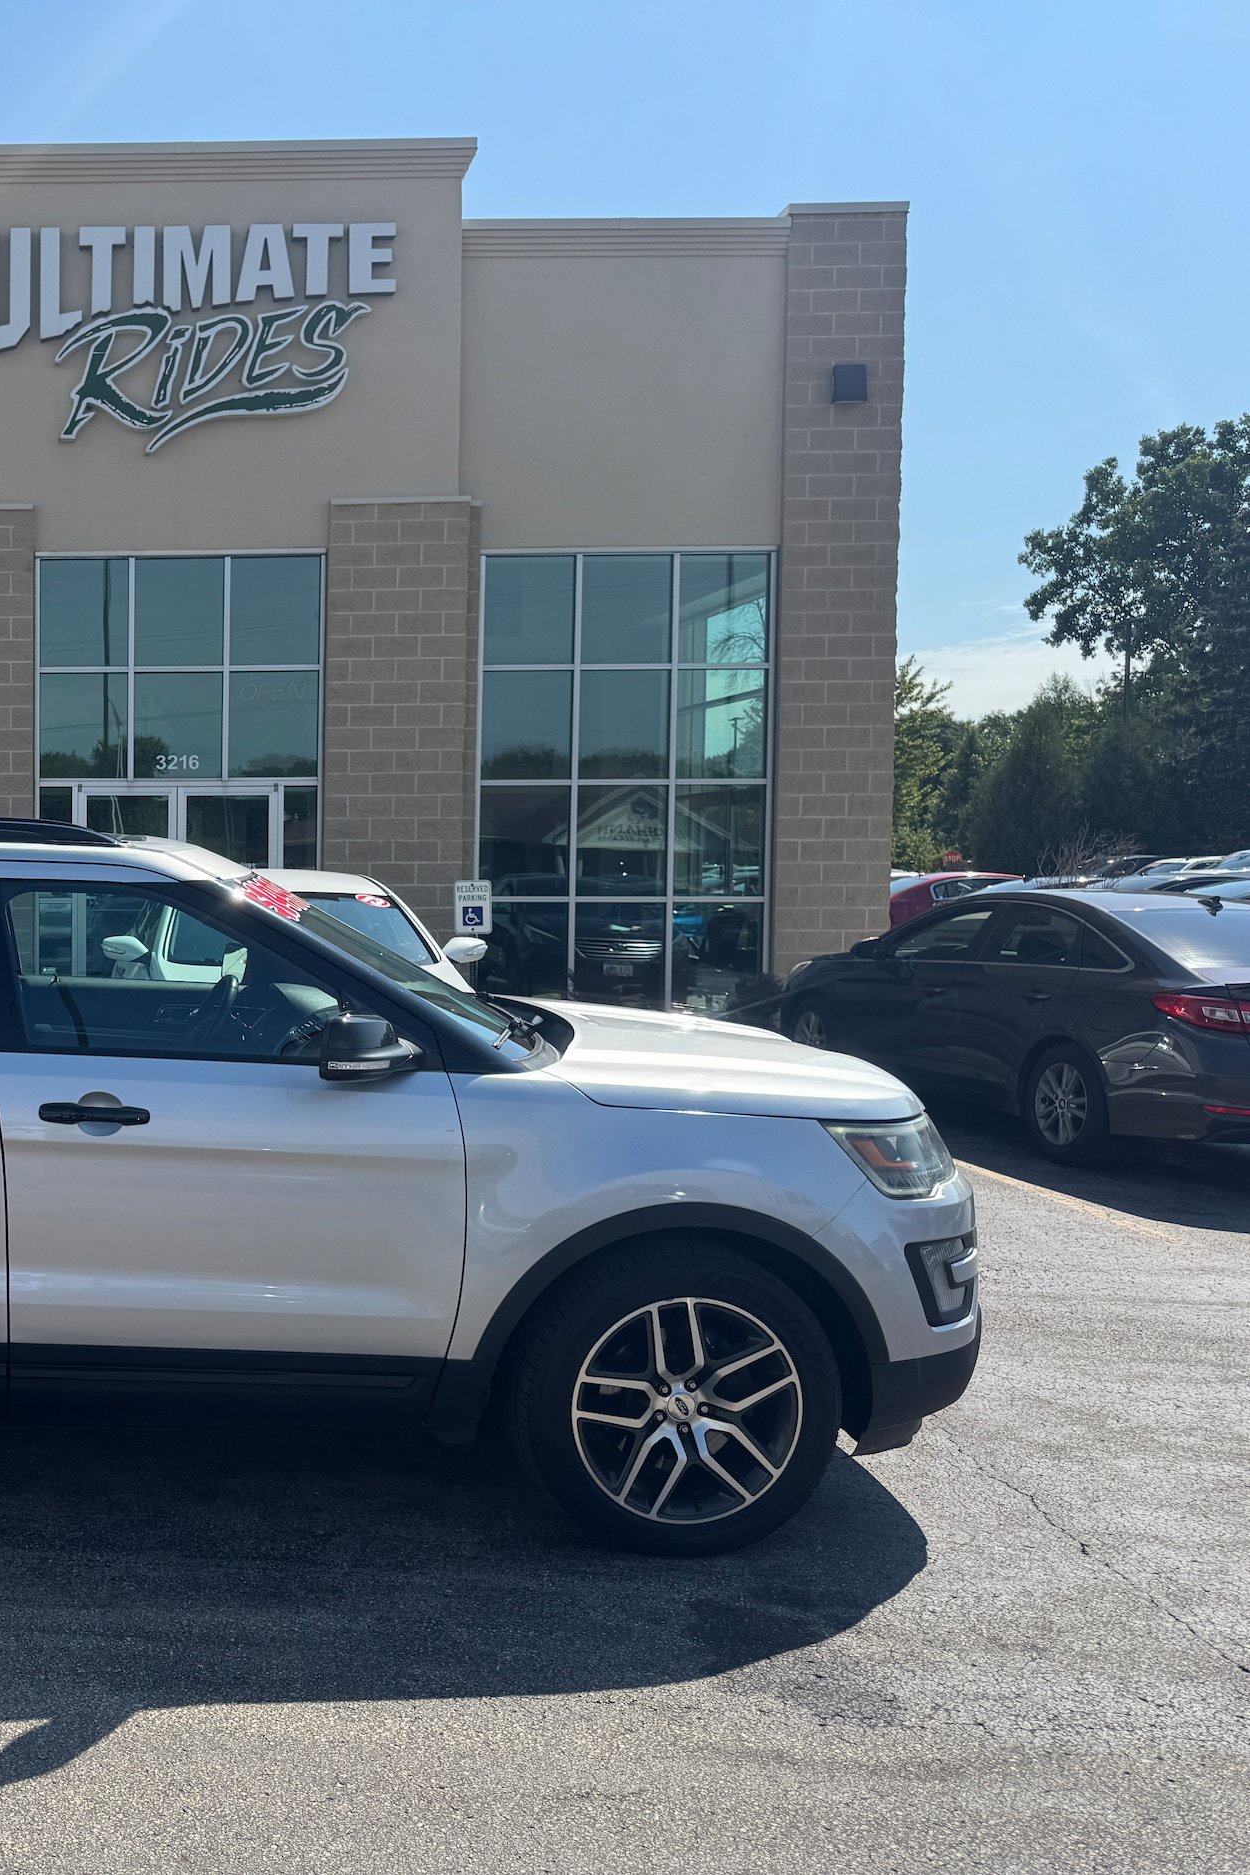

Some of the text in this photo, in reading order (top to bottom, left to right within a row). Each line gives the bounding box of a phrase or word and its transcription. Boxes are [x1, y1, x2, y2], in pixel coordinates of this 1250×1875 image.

[239, 682, 307, 701] OPEN
[155, 754, 200, 770] 3216
[456, 885, 488, 893] RESERVED
[458, 894, 487, 902] PARKING
